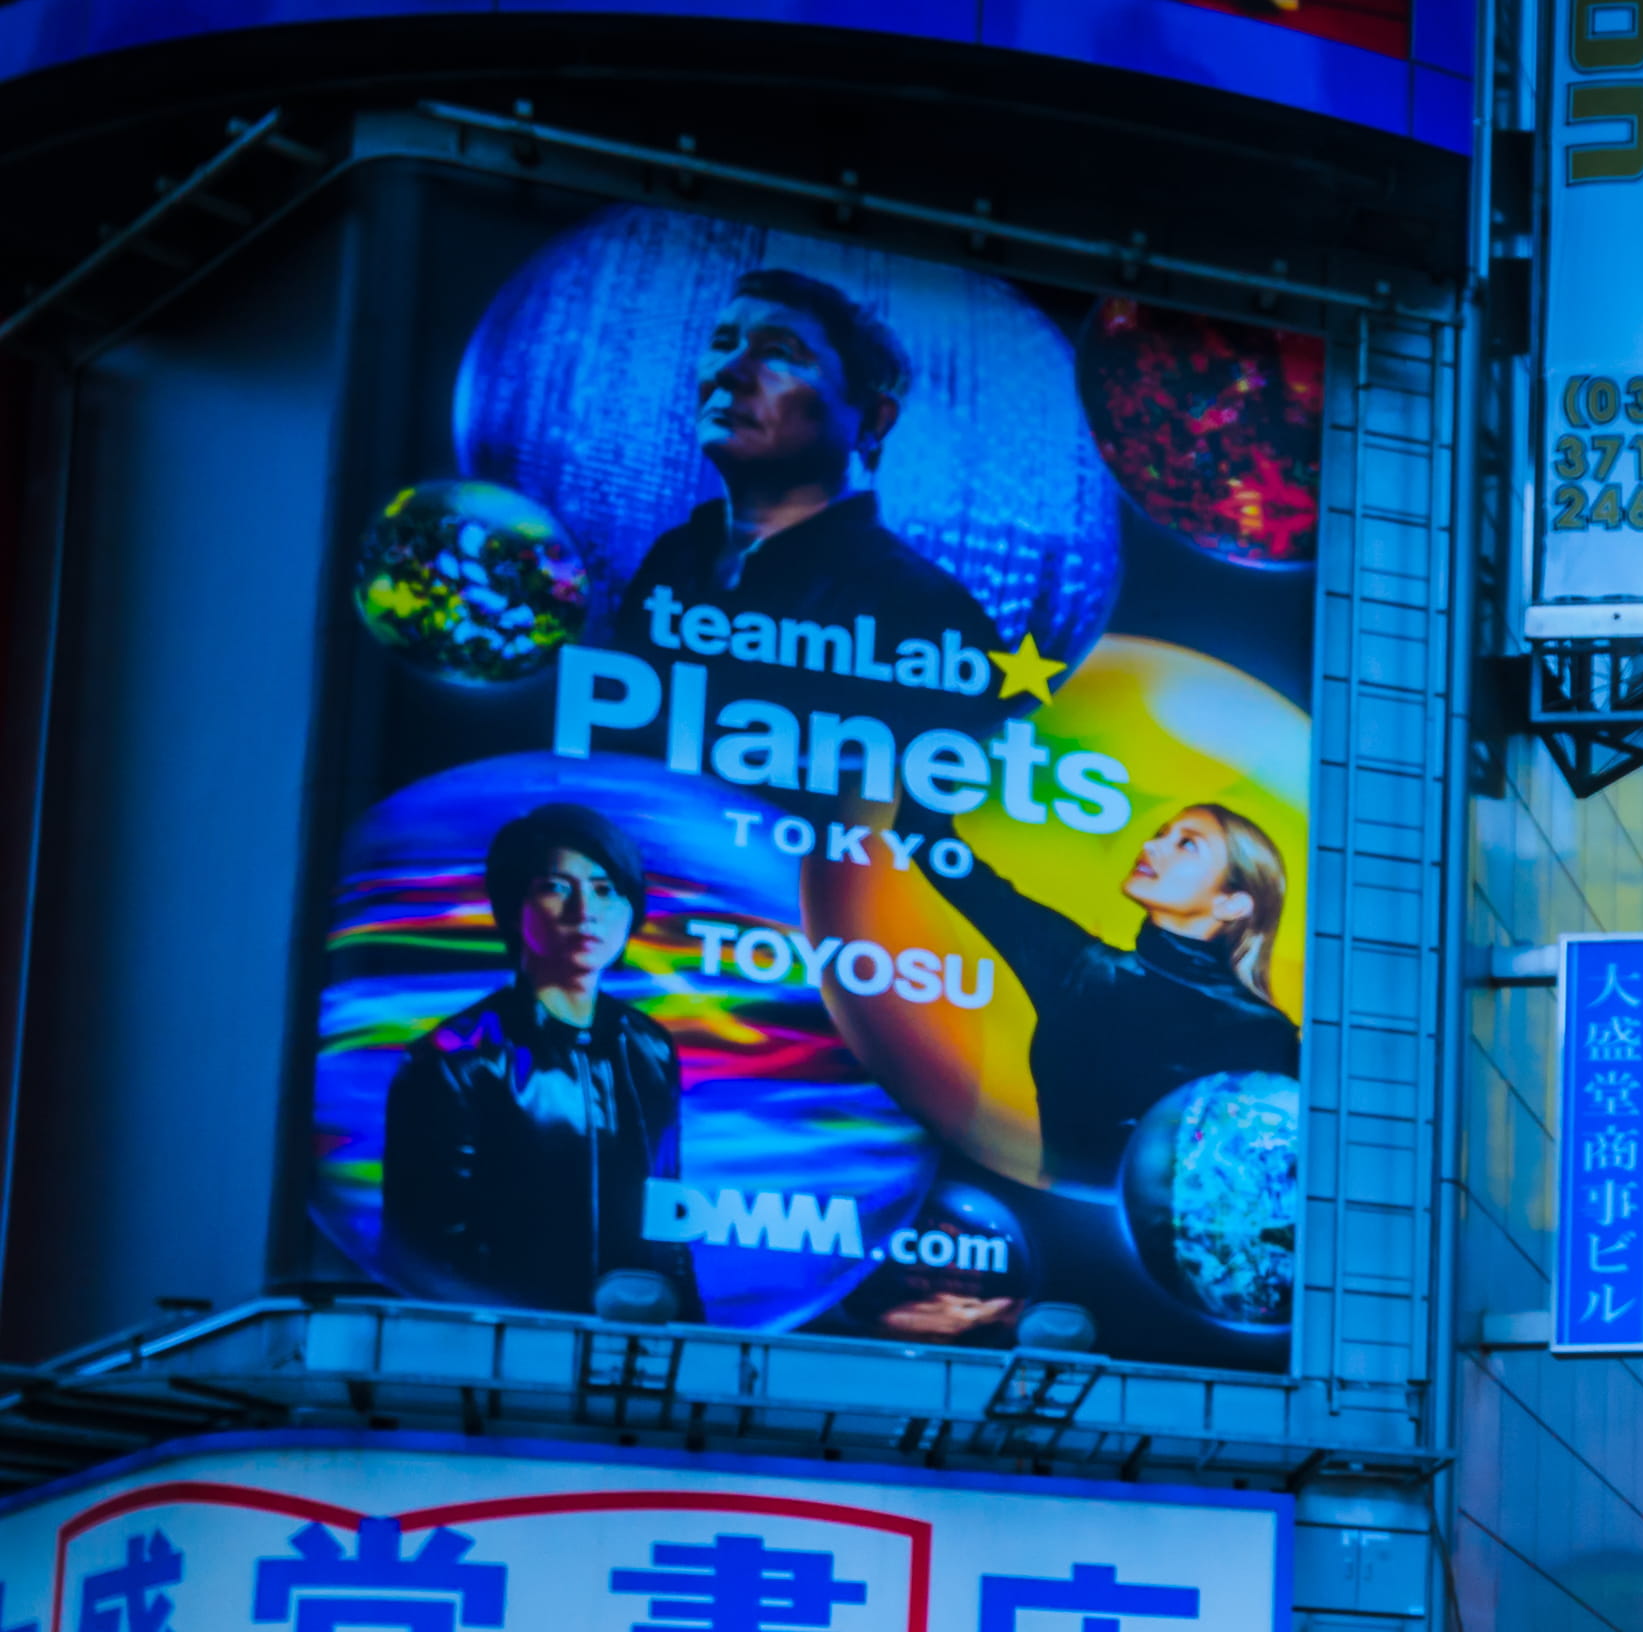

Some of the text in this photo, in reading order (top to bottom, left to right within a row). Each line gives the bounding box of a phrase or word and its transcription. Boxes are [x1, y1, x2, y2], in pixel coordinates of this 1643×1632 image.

[643, 586, 990, 695] teamLab
[553, 644, 1131, 834] Planets
[725, 811, 973, 878] TOKYO
[687, 921, 995, 1011] TOYOSU
[1579, 962, 1642, 1326] 大盛堂商事ビル
[643, 1176, 1009, 1273] DMM.com
